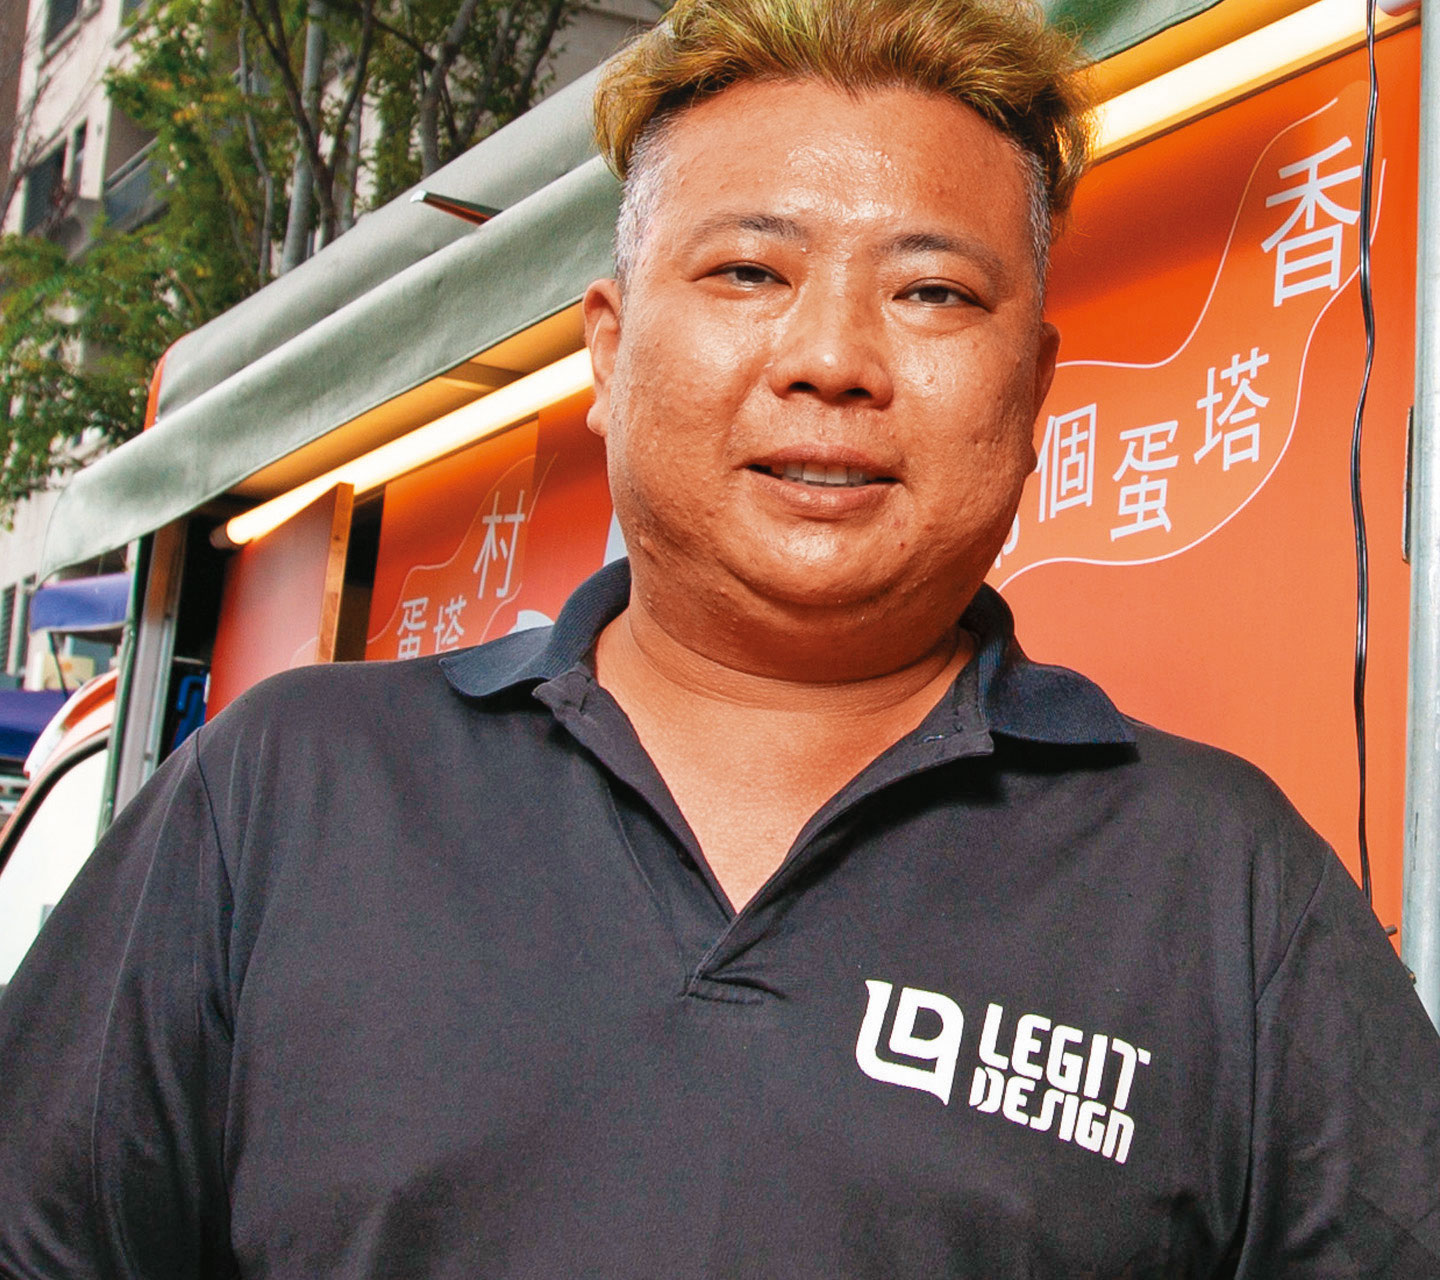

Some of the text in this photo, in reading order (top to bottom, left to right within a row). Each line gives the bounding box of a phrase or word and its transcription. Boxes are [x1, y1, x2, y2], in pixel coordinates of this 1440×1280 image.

[1261, 136, 1361, 307] 香
[997, 347, 1269, 568] 個蛋塔
[473, 490, 525, 599] 村
[978, 1003, 1151, 1110] LEGIT
[969, 1067, 1135, 1164] DESIGN
